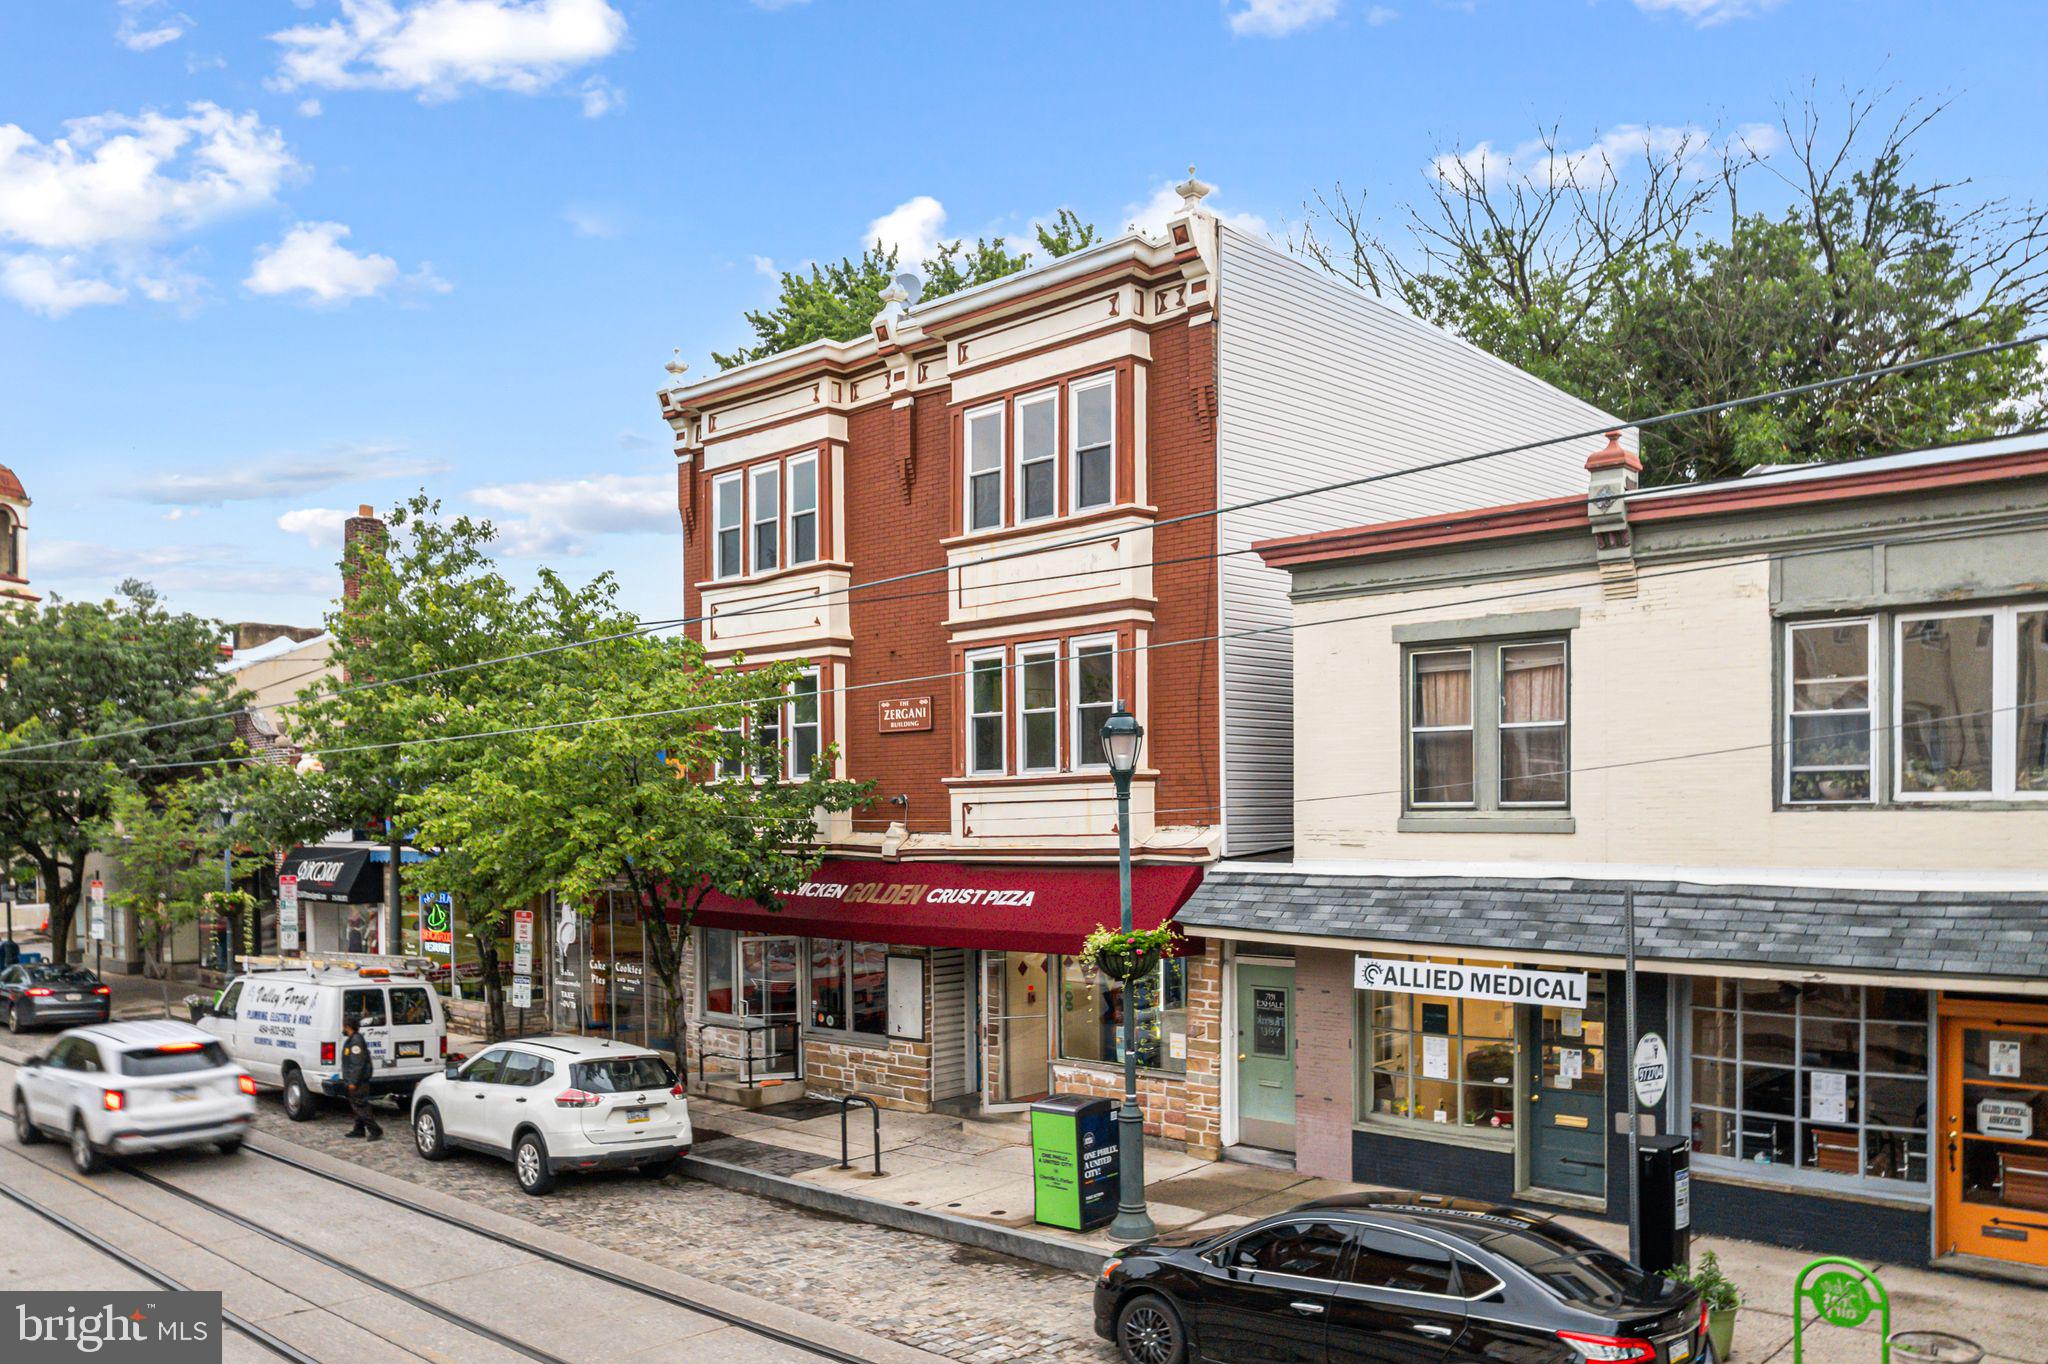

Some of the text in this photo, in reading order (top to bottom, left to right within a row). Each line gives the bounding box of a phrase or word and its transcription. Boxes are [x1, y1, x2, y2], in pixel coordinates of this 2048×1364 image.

[884, 707, 926, 720] ZERGANI
[782, 882, 848, 899] HICKEN
[843, 883, 929, 905] GOLDEN
[926, 888, 987, 905] CRUST
[981, 890, 1035, 906] PIZZA
[589, 960, 606, 970] Cake
[615, 962, 642, 975] Cookies
[591, 973, 605, 985] Pies
[1383, 966, 1582, 1001] ALLIED MEDICAL
[256, 986, 309, 1011] Valley Forge
[561, 991, 575, 999] TAKE
[299, 1015, 312, 1025] HVAC
[1639, 1066, 1663, 1082] 972704
[1084, 1150, 1098, 1160] ONE
[1084, 1156, 1112, 1170] A UNITED
[1084, 1168, 1101, 1178] CITY!
